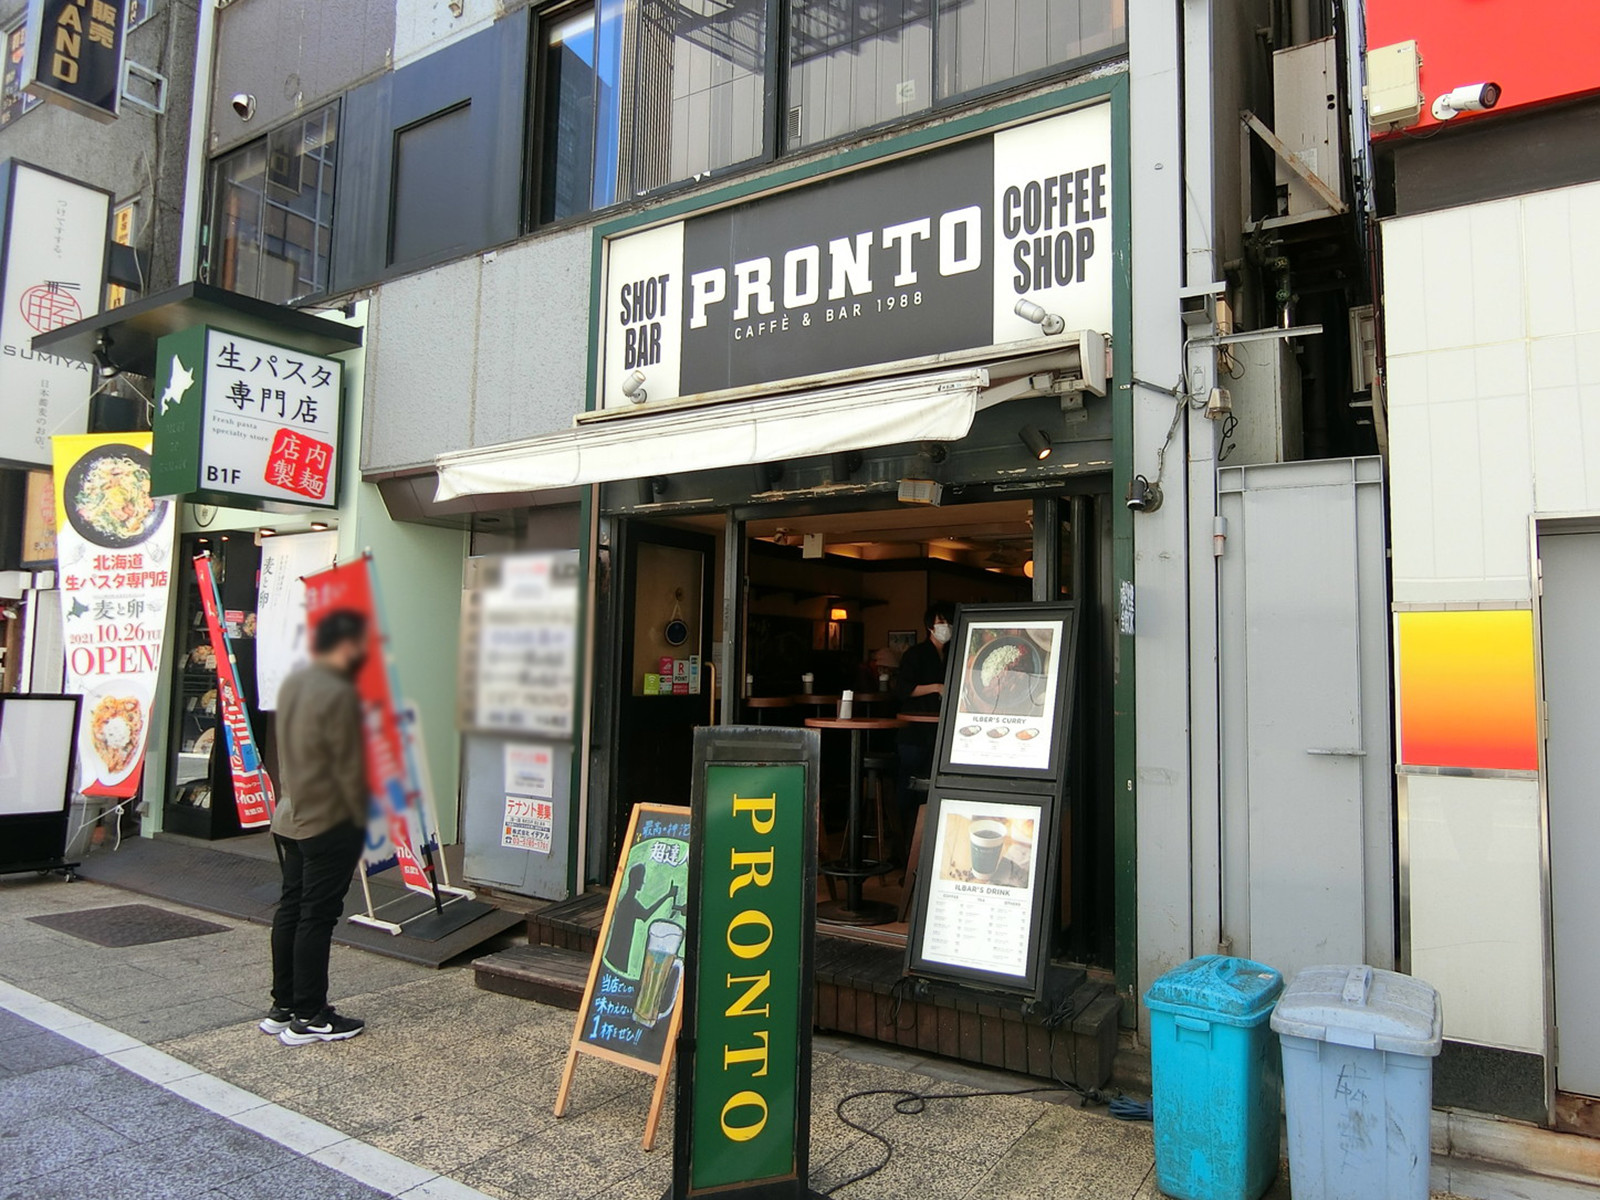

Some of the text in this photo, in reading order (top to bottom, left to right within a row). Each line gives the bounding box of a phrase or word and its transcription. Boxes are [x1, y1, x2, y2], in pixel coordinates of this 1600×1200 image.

[52, 0, 86, 84] AND
[1003, 164, 1107, 240] COFFEE
[690, 205, 983, 330] PRONTO
[1013, 227, 1095, 295] SHOP
[620, 273, 670, 326] SHOT
[734, 291, 923, 341] CAFFÈ & BAR 1988
[3, 344, 89, 372] SUMIYA
[216, 341, 333, 390] 生パスタ
[624, 322, 662, 370] BAR
[212, 415, 258, 431] Fresh pasta
[225, 380, 319, 424] 専門店
[212, 426, 270, 443] specialty store
[207, 465, 242, 484] B1F
[65, 570, 168, 591] 生パスタ専門店
[93, 553, 143, 571] 北海道
[93, 598, 145, 620] 麦と卵
[70, 632, 94, 644] 2021
[97, 621, 145, 643] 10.26
[720, 792, 778, 1142] PRONTO
